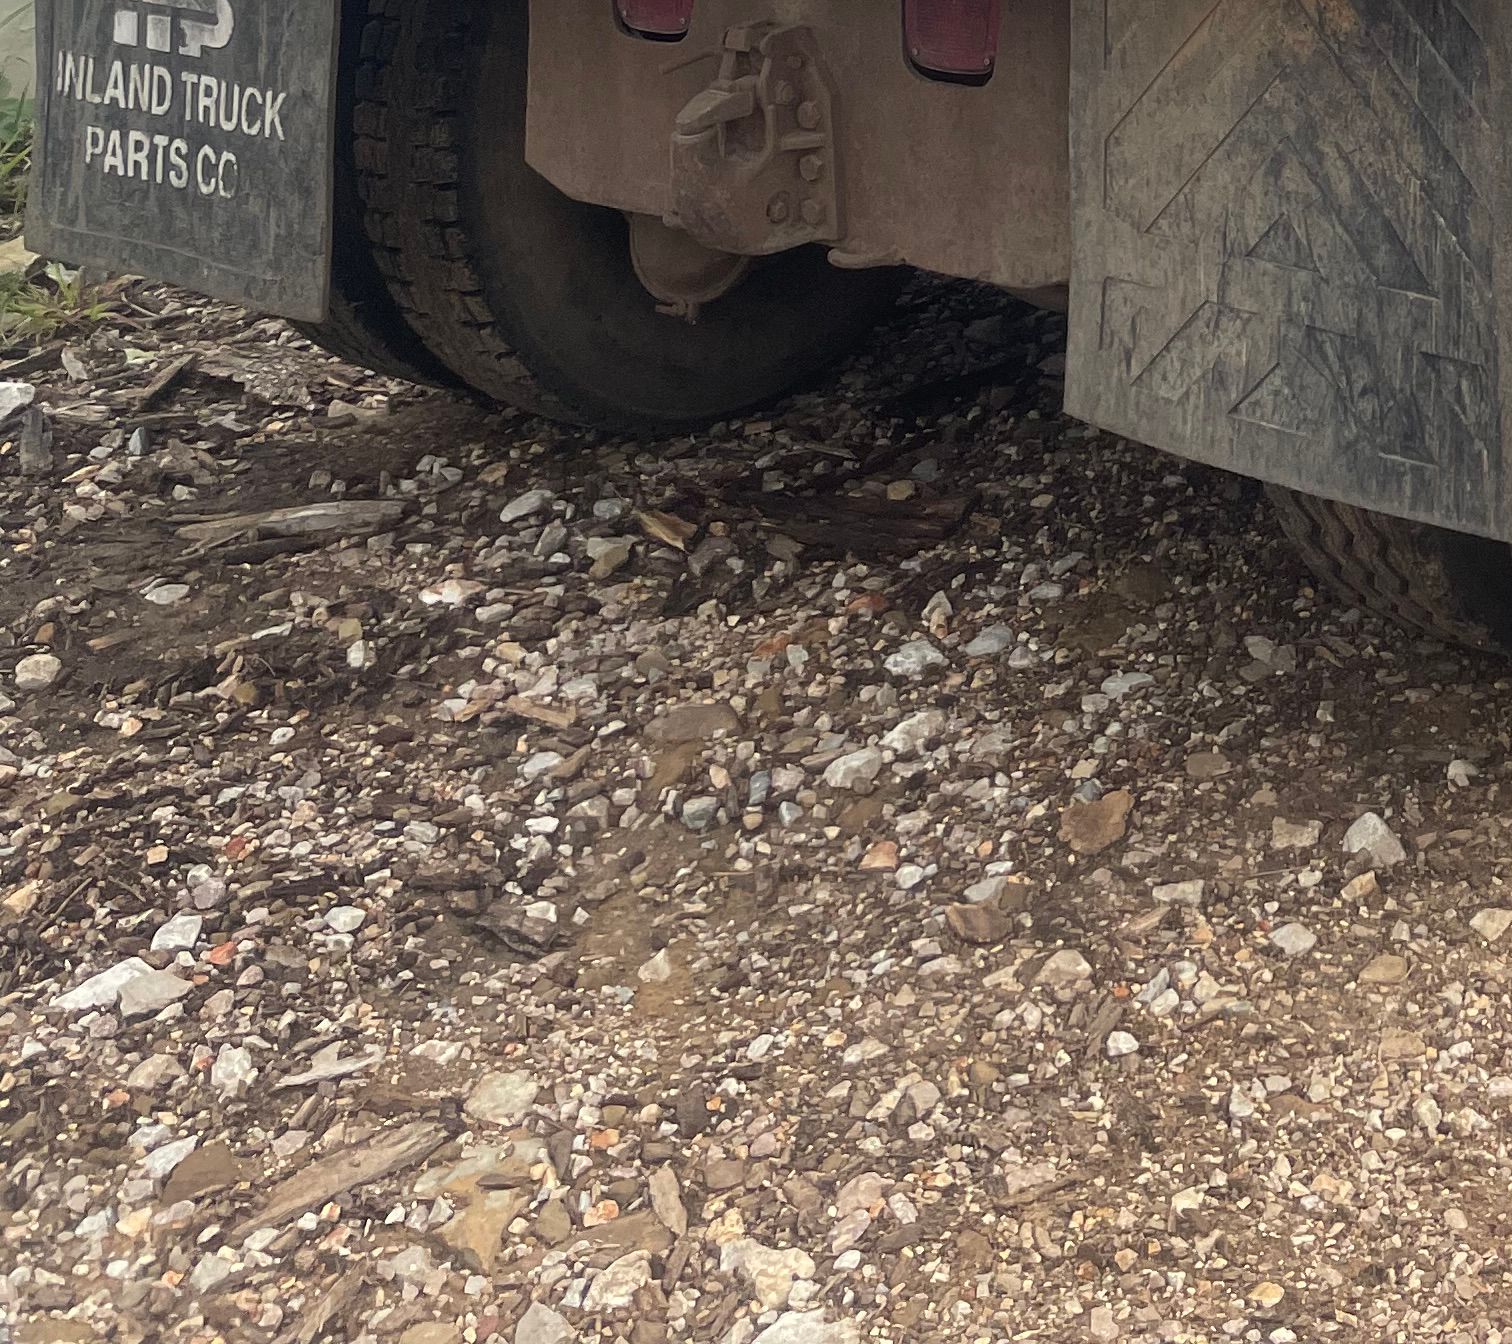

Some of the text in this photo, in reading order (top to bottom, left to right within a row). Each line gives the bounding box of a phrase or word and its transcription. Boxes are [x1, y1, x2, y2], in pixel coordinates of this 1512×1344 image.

[56, 50, 287, 141] INLAND TRUCK
[85, 125, 239, 199] PARTS CO
